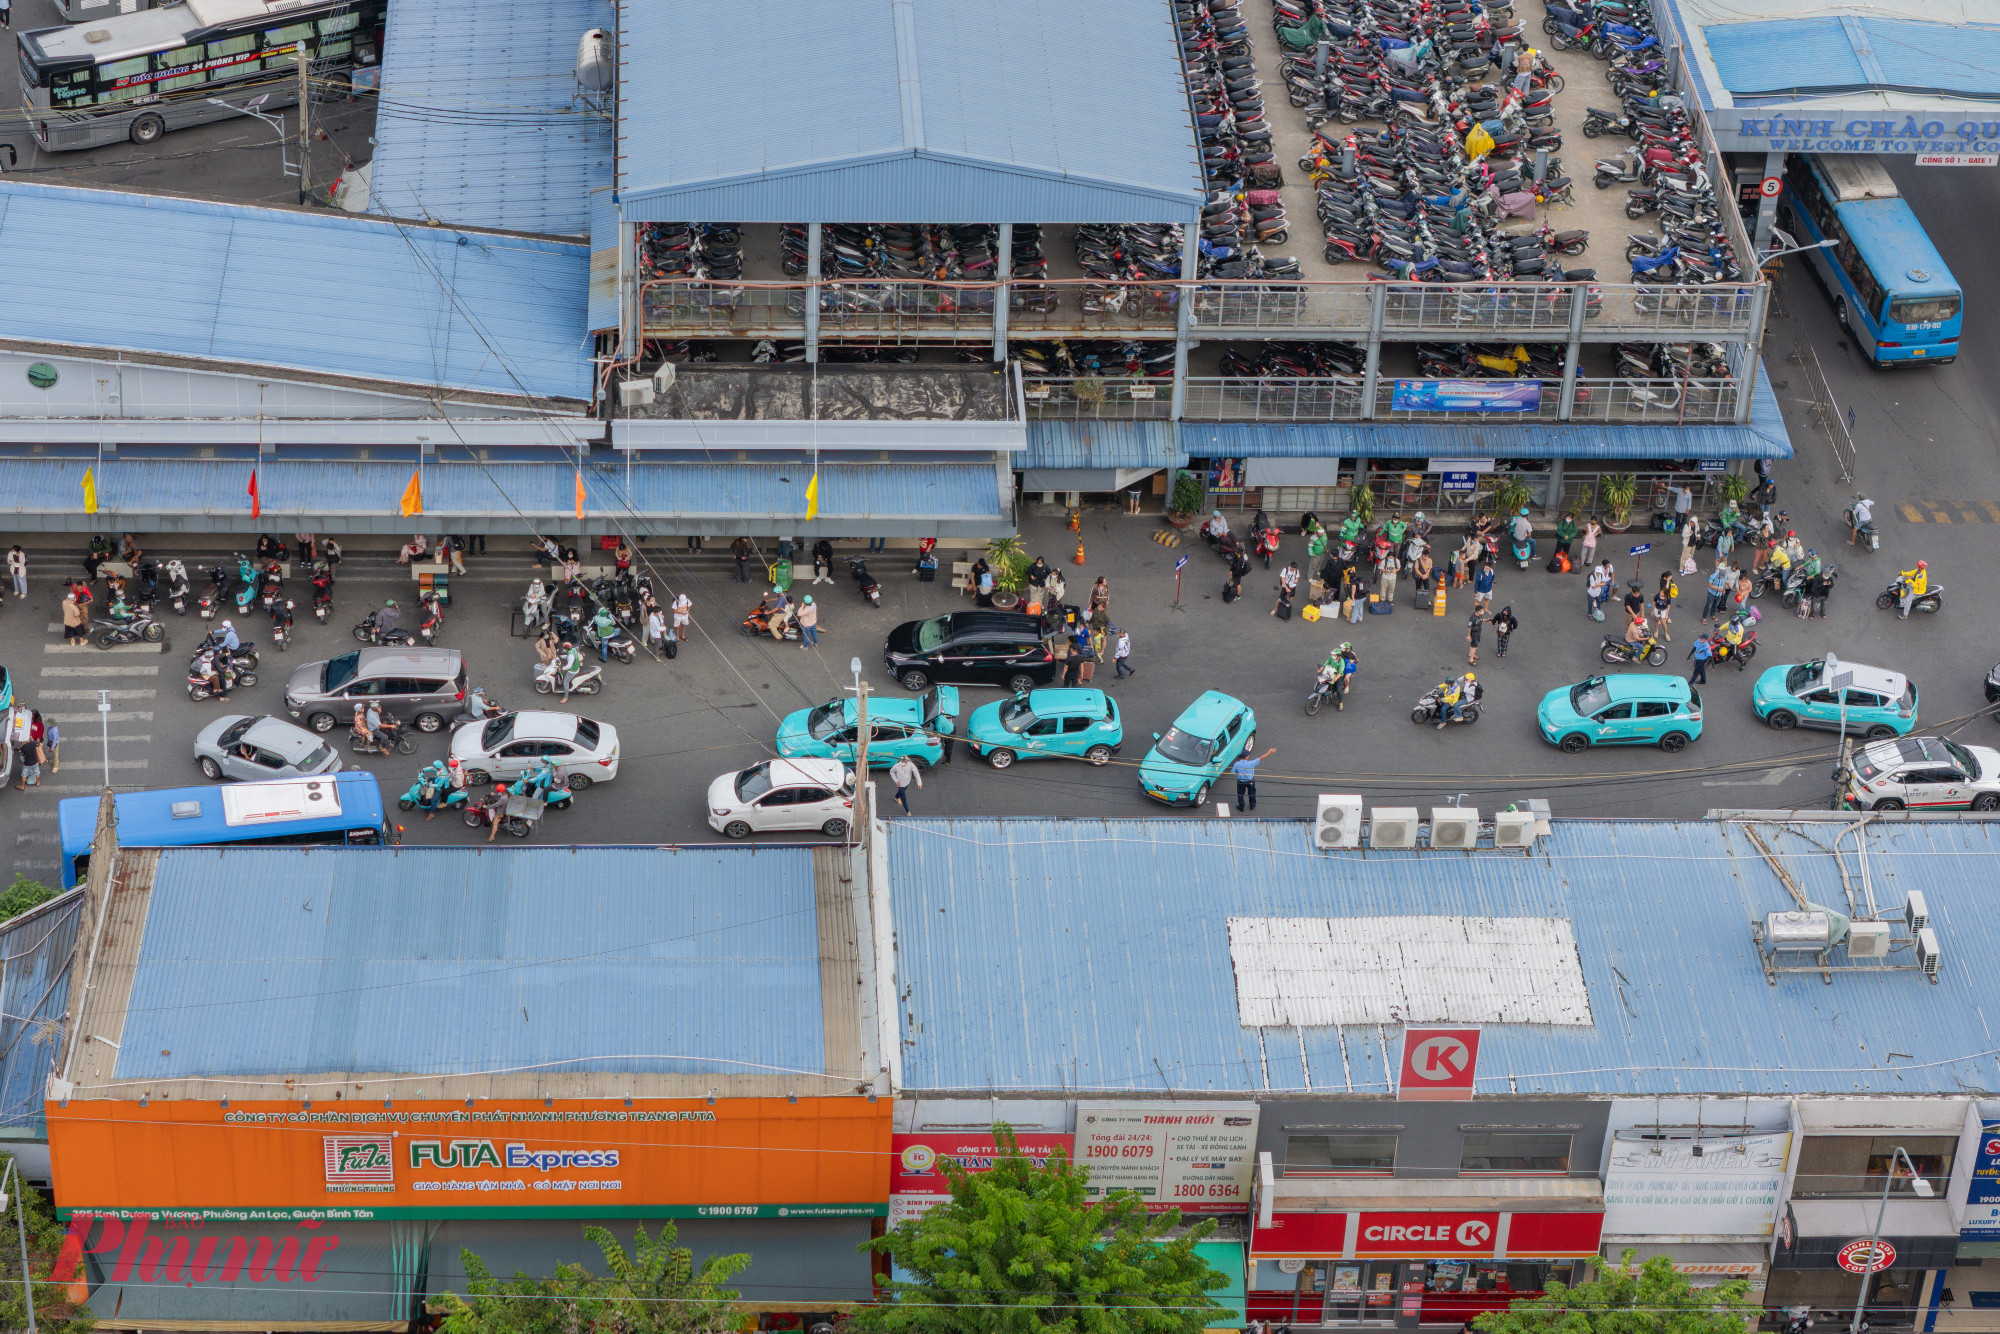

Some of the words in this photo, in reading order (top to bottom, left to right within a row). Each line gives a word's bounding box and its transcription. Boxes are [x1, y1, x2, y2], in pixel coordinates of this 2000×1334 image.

[192, 62, 203, 70] 34
[206, 56, 234, 68] PHÒNG
[236, 53, 250, 62] VIP
[57, 88, 86, 99] Home
[1738, 113, 1835, 137] KÍNH
[1846, 115, 1945, 138] CHÀO
[1957, 120, 2000, 142] QU
[1770, 139, 1876, 151] WELCOME
[1881, 140, 1908, 151] TO
[1912, 141, 1970, 152] WEST
[1922, 156, 1943, 164] CỔNG
[1944, 155, 1955, 164] SỐ
[1767, 182, 1775, 191] 5
[224, 1110, 266, 1122] CÔNG
[268, 1113, 286, 1122] TY
[287, 1110, 309, 1122] CỔ
[310, 1111, 349, 1122] PHẦN
[352, 1112, 387, 1124] DỊCH
[388, 1112, 408, 1124] VỤ
[410, 1110, 469, 1122] CHUYỂN
[472, 1110, 510, 1122] PHÁT
[511, 1112, 564, 1122] NHANH
[565, 1111, 627, 1122] PHƯƠNG
[629, 1112, 677, 1122] TRANG
[679, 1112, 716, 1121] FUTA
[1144, 1115, 1182, 1124] THÀNH
[1185, 1114, 1214, 1124] BƯỞI
[1091, 1133, 1111, 1142] Tổng
[410, 1140, 502, 1168] FUTA
[506, 1143, 619, 1172] Express
[1087, 1146, 1118, 1157] 1900
[1122, 1146, 1153, 1157] 6079
[413, 1182, 441, 1190] GIAO
[442, 1180, 474, 1190] HÀNG
[476, 1180, 499, 1192] TẬN
[501, 1180, 526, 1190] NHÀ
[534, 1180, 550, 1190] CÓ
[553, 1181, 576, 1192] MẶT
[579, 1181, 599, 1190] NƠI
[601, 1181, 621, 1190] NƠI
[1174, 1185, 1205, 1196] 1800
[1209, 1185, 1239, 1196] 6364
[72, 1210, 94, 1218] 395
[95, 1208, 120, 1218] Kinh
[121, 1209, 159, 1220] Dương
[203, 1208, 247, 1220] Phường
[250, 1210, 265, 1218] An
[267, 1210, 291, 1221] Lạc,
[292, 1208, 325, 1220] Quận
[327, 1208, 352, 1218] Bình
[354, 1208, 374, 1218] Tân
[708, 1207, 732, 1215] 1900
[1365, 1226, 1451, 1241] CIRCLE
[1842, 1242, 1893, 1256] HIGHLNDS
[1683, 1264, 1757, 1273] DUYÊN
[1846, 1264, 1884, 1272] COFEE
